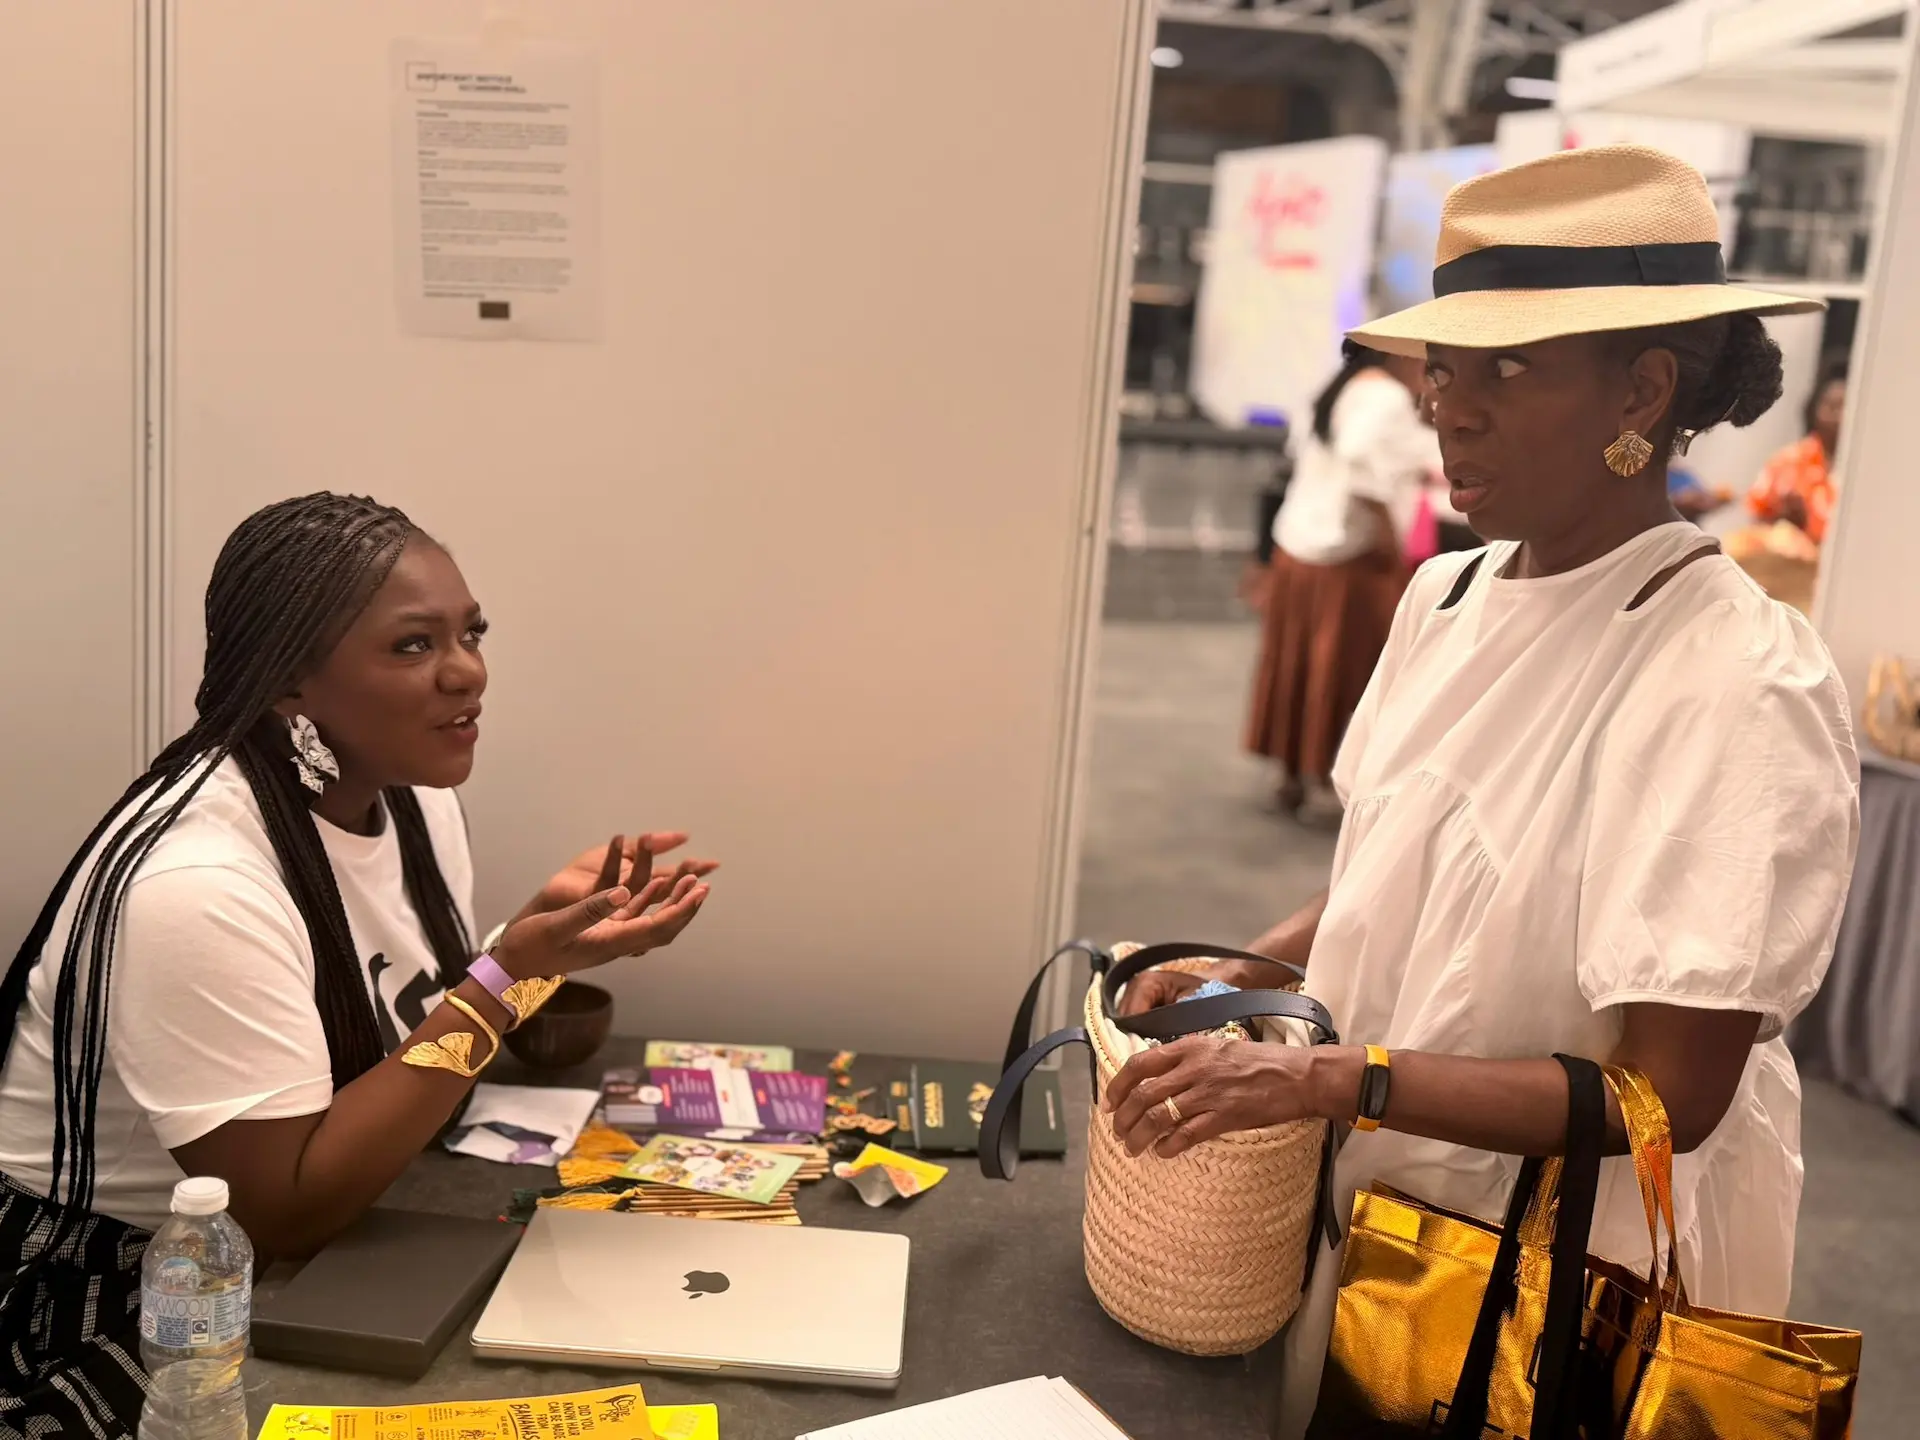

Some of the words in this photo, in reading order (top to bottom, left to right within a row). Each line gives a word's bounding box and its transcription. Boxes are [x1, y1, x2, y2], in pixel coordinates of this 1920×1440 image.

[547, 1401, 561, 1414] CAN
[562, 1401, 574, 1421] KNOW
[578, 1404, 592, 1417] DID
[509, 1403, 541, 1440] BANANAS
[536, 1413, 549, 1430] FROM
[550, 1414, 562, 1423] BE
[581, 1417, 595, 1431] YOU
[551, 1423, 566, 1440] MADE
[567, 1421, 581, 1437] HAIR
